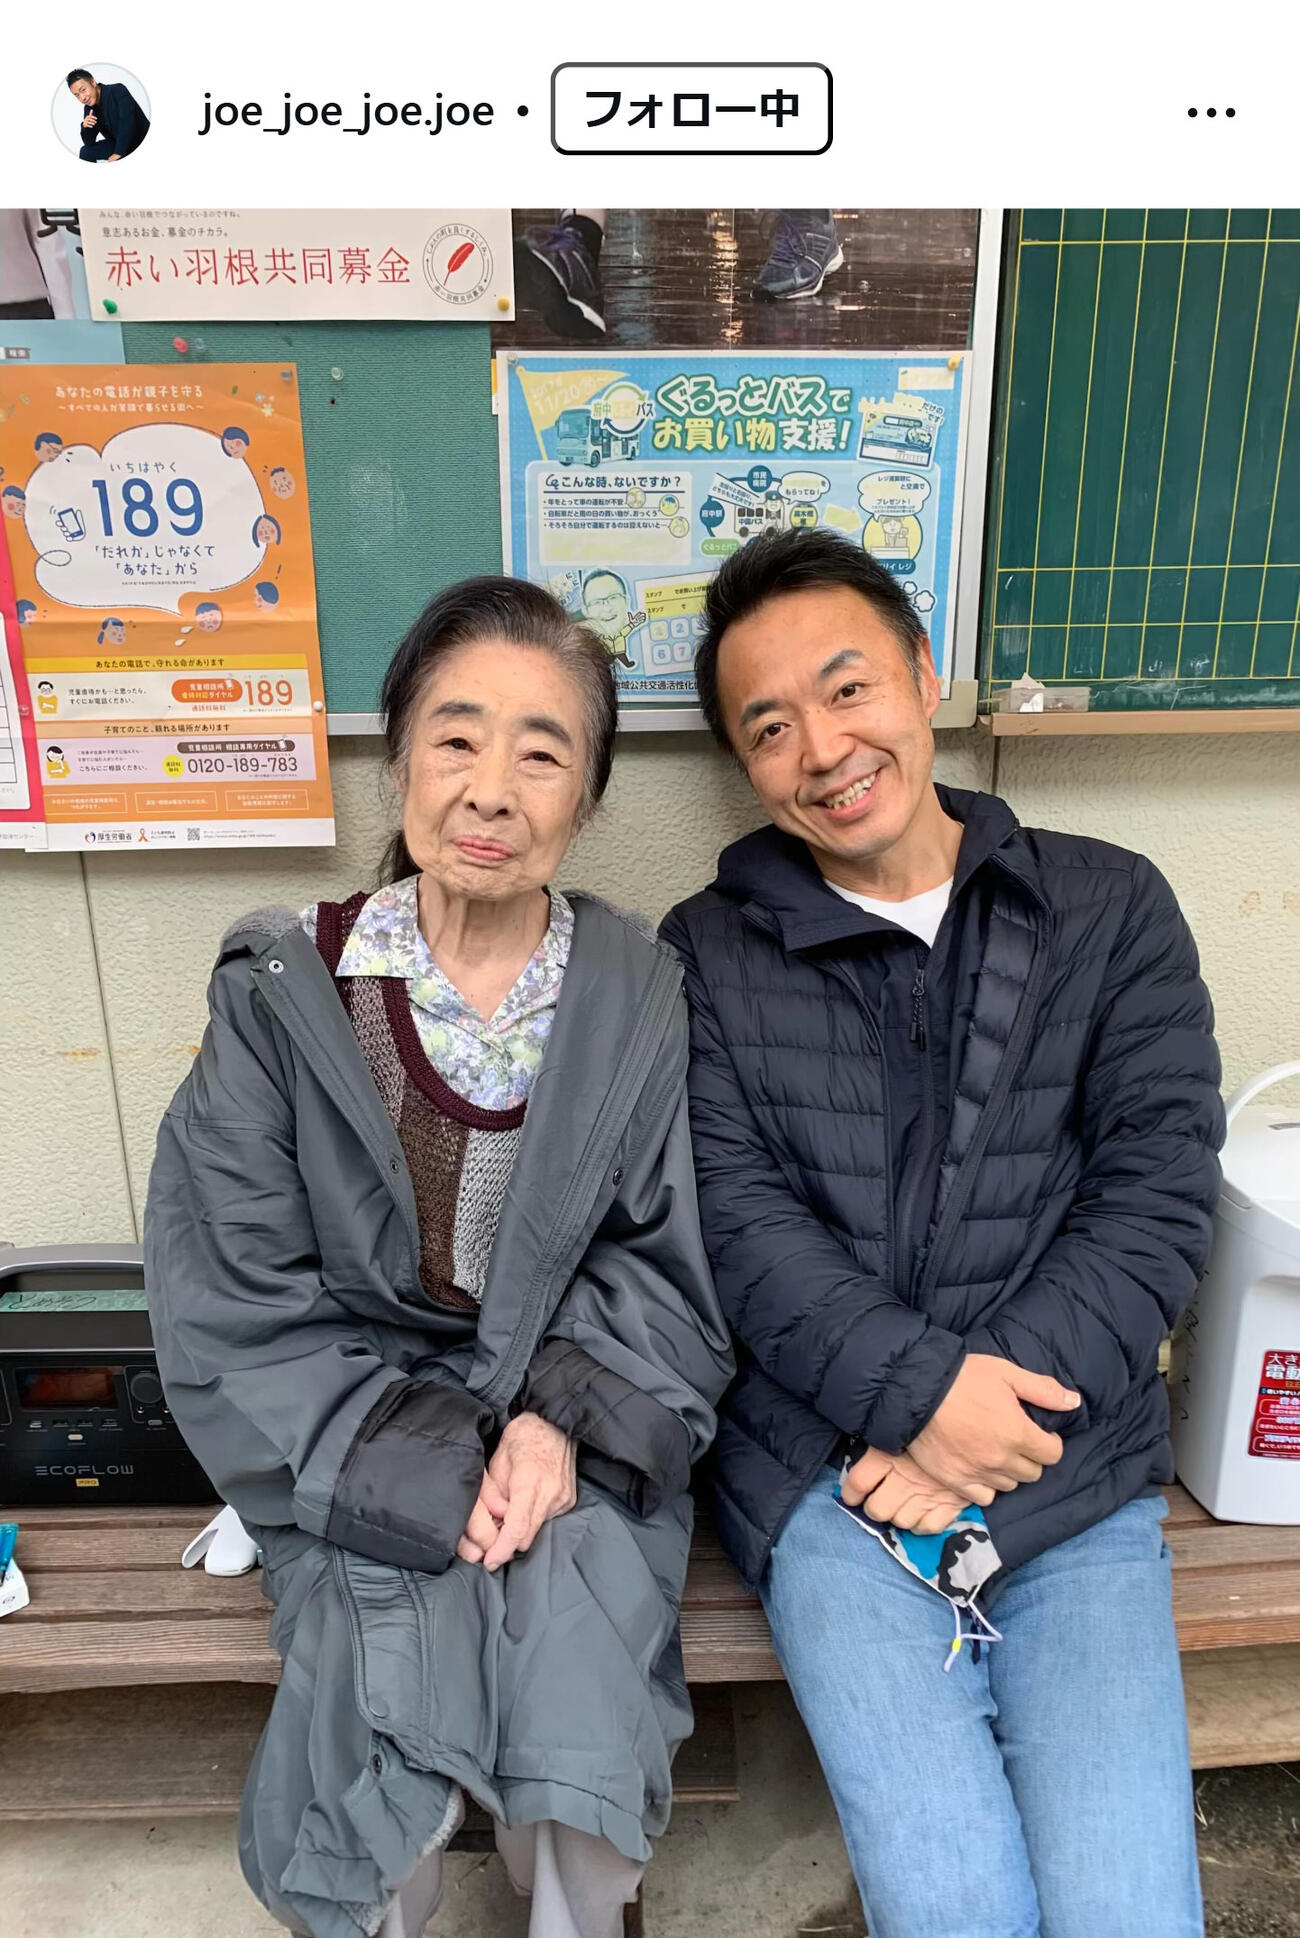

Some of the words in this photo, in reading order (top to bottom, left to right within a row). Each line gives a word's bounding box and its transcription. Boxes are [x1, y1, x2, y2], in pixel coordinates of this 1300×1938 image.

[102, 226, 229, 239] 意志あるお金、募金のチカラ。
[105, 246, 411, 287] 赤い羽根共同募金
[55, 385, 203, 399] あなたの電話が親子を守る
[656, 374, 852, 416] ぐるっとバスで
[635, 402, 655, 418] バス
[652, 417, 852, 452] お買い物支援!
[109, 461, 177, 474] いちはやく
[562, 476, 681, 488] こんな時、ないですか?
[92, 477, 204, 537] 189
[95, 544, 216, 559] 「だれか」じゃなくて
[116, 562, 199, 576] 「あなた」から
[674, 622, 685, 634] 2
[657, 649, 667, 660] 6
[679, 645, 689, 657] 7
[244, 679, 294, 707] 189
[187, 757, 298, 774] 0120-189-783
[35, 1465, 135, 1476] ECOFLOW
